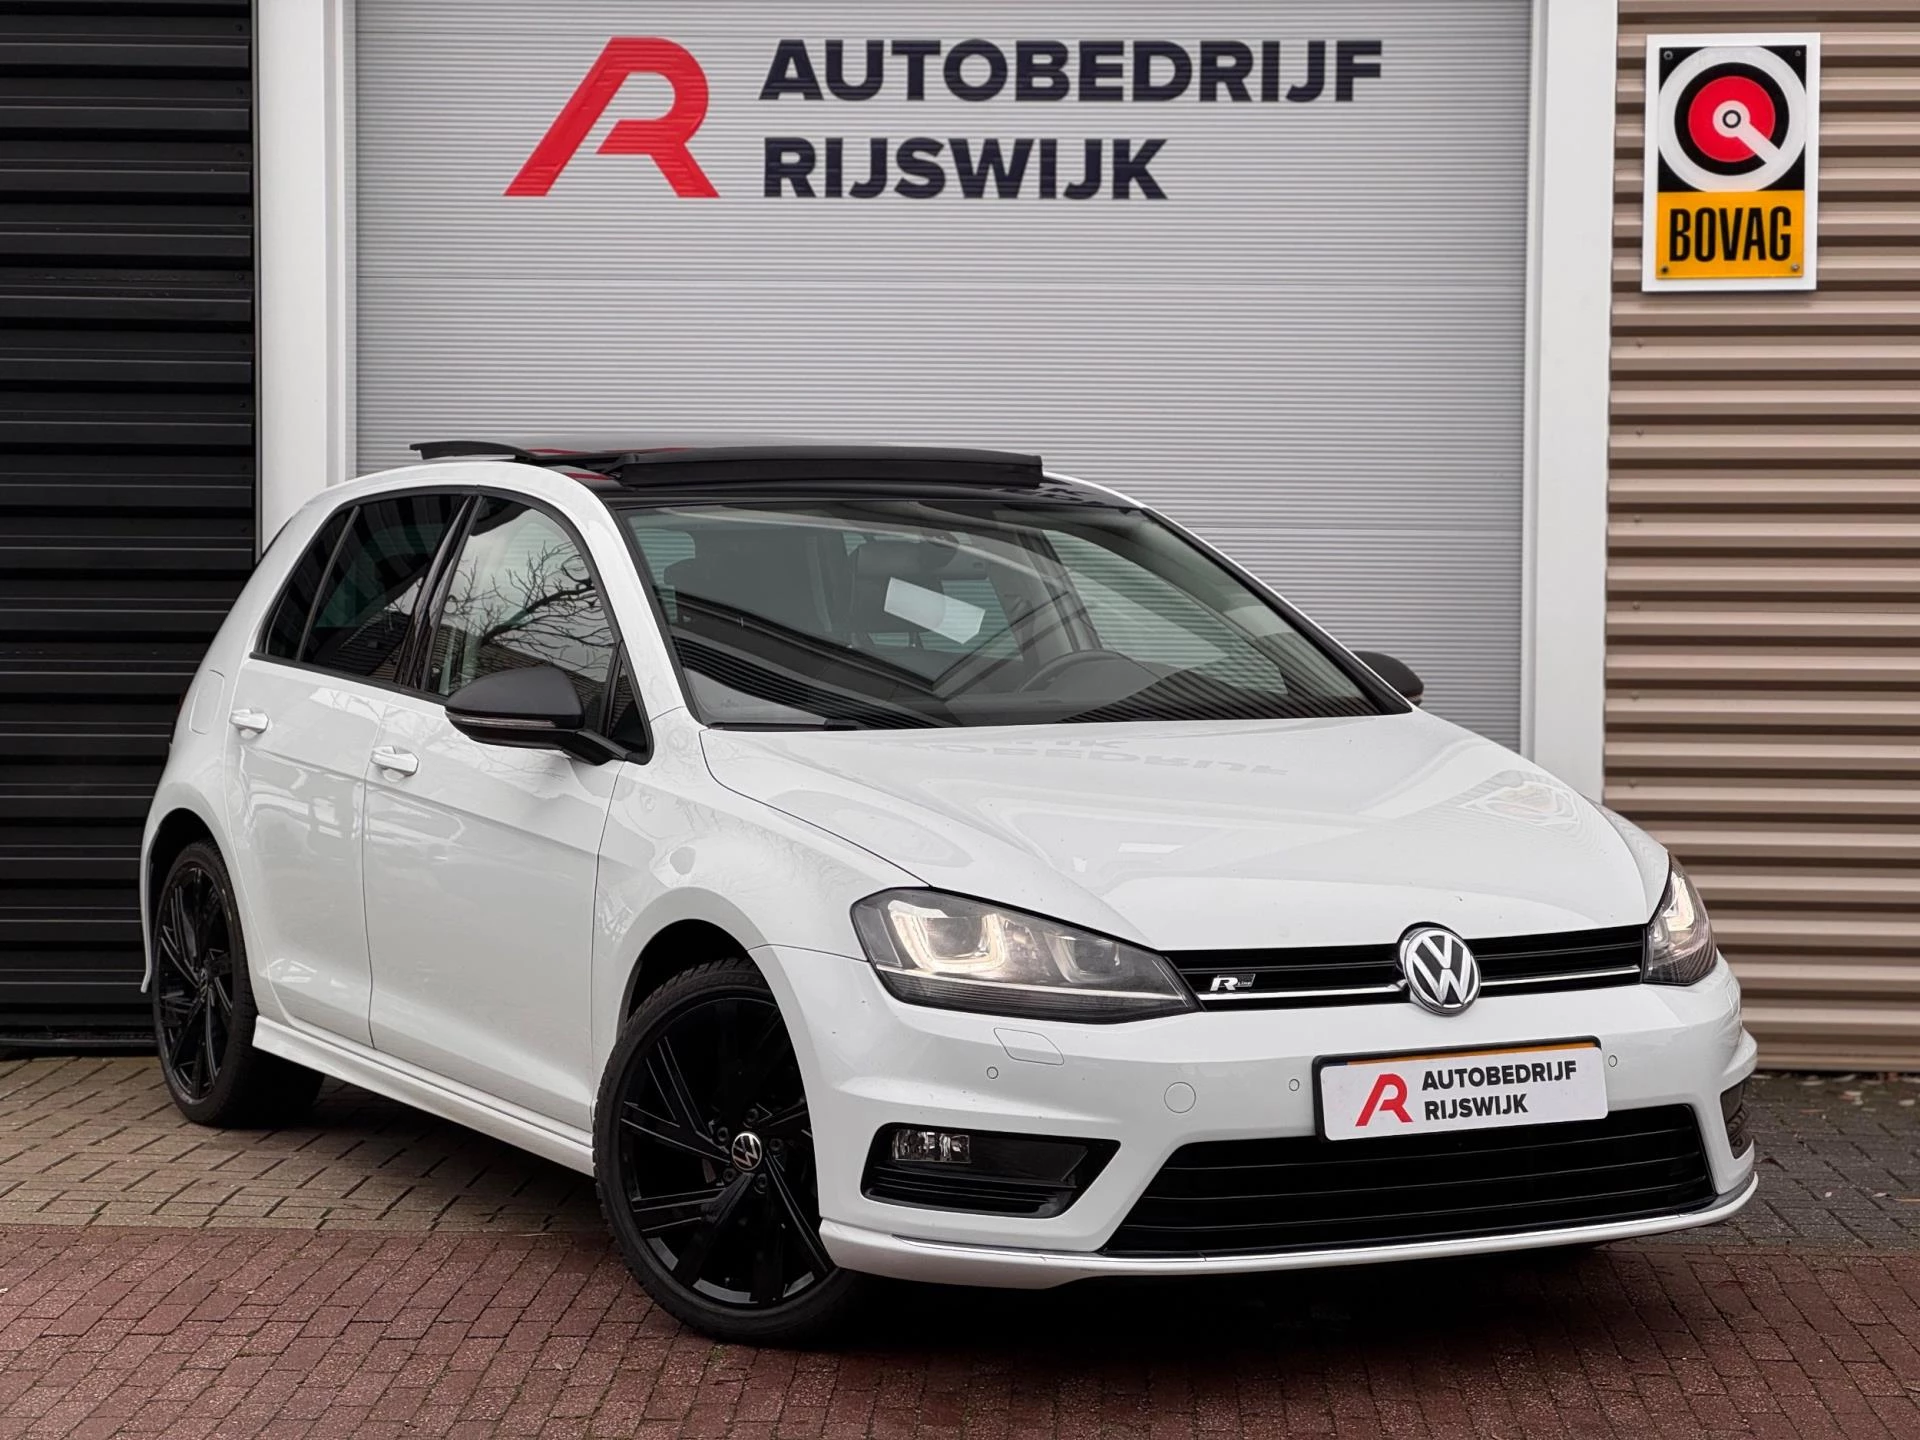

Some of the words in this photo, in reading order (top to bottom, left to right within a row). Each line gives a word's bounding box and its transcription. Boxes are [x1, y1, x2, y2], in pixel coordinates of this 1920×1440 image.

[759, 39, 1383, 103] AUTOBEDRIJF
[763, 137, 1168, 200] RIJSWIJK
[1669, 206, 1792, 262] BOVAG
[1421, 1060, 1577, 1091] AUTOBEDRIJF
[1424, 1094, 1529, 1121] RIJSWIJK
